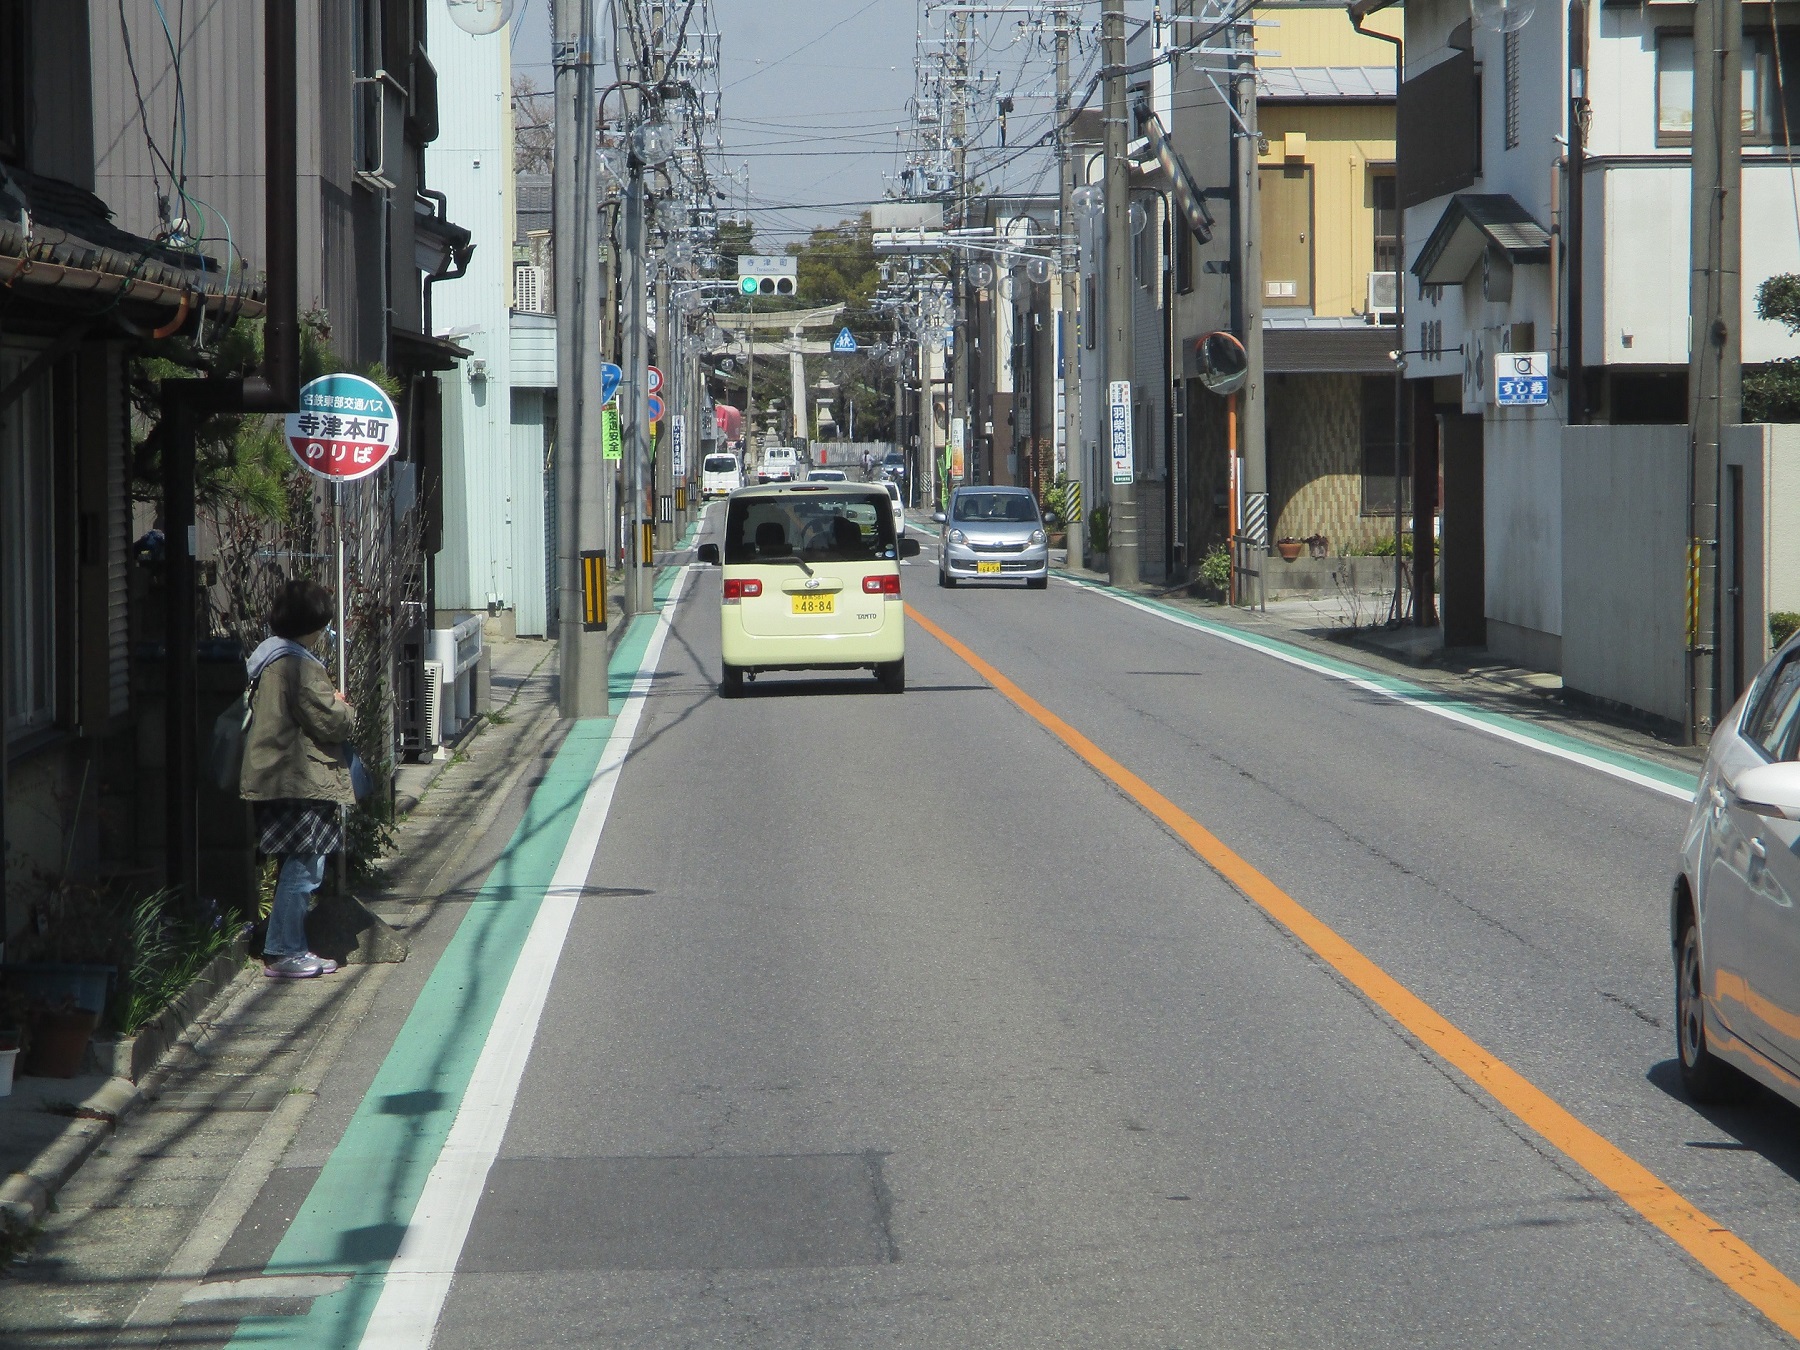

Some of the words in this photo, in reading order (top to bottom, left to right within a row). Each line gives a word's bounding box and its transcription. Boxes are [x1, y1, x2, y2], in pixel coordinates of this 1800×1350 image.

[304, 394, 383, 412] 名鉄東部交通バス
[298, 413, 389, 442] 寺津本町
[608, 411, 619, 452] 交通安全
[1113, 406, 1126, 457] 羽柴設備
[306, 442, 374, 463] のりば
[801, 601, 832, 612] 48-84
